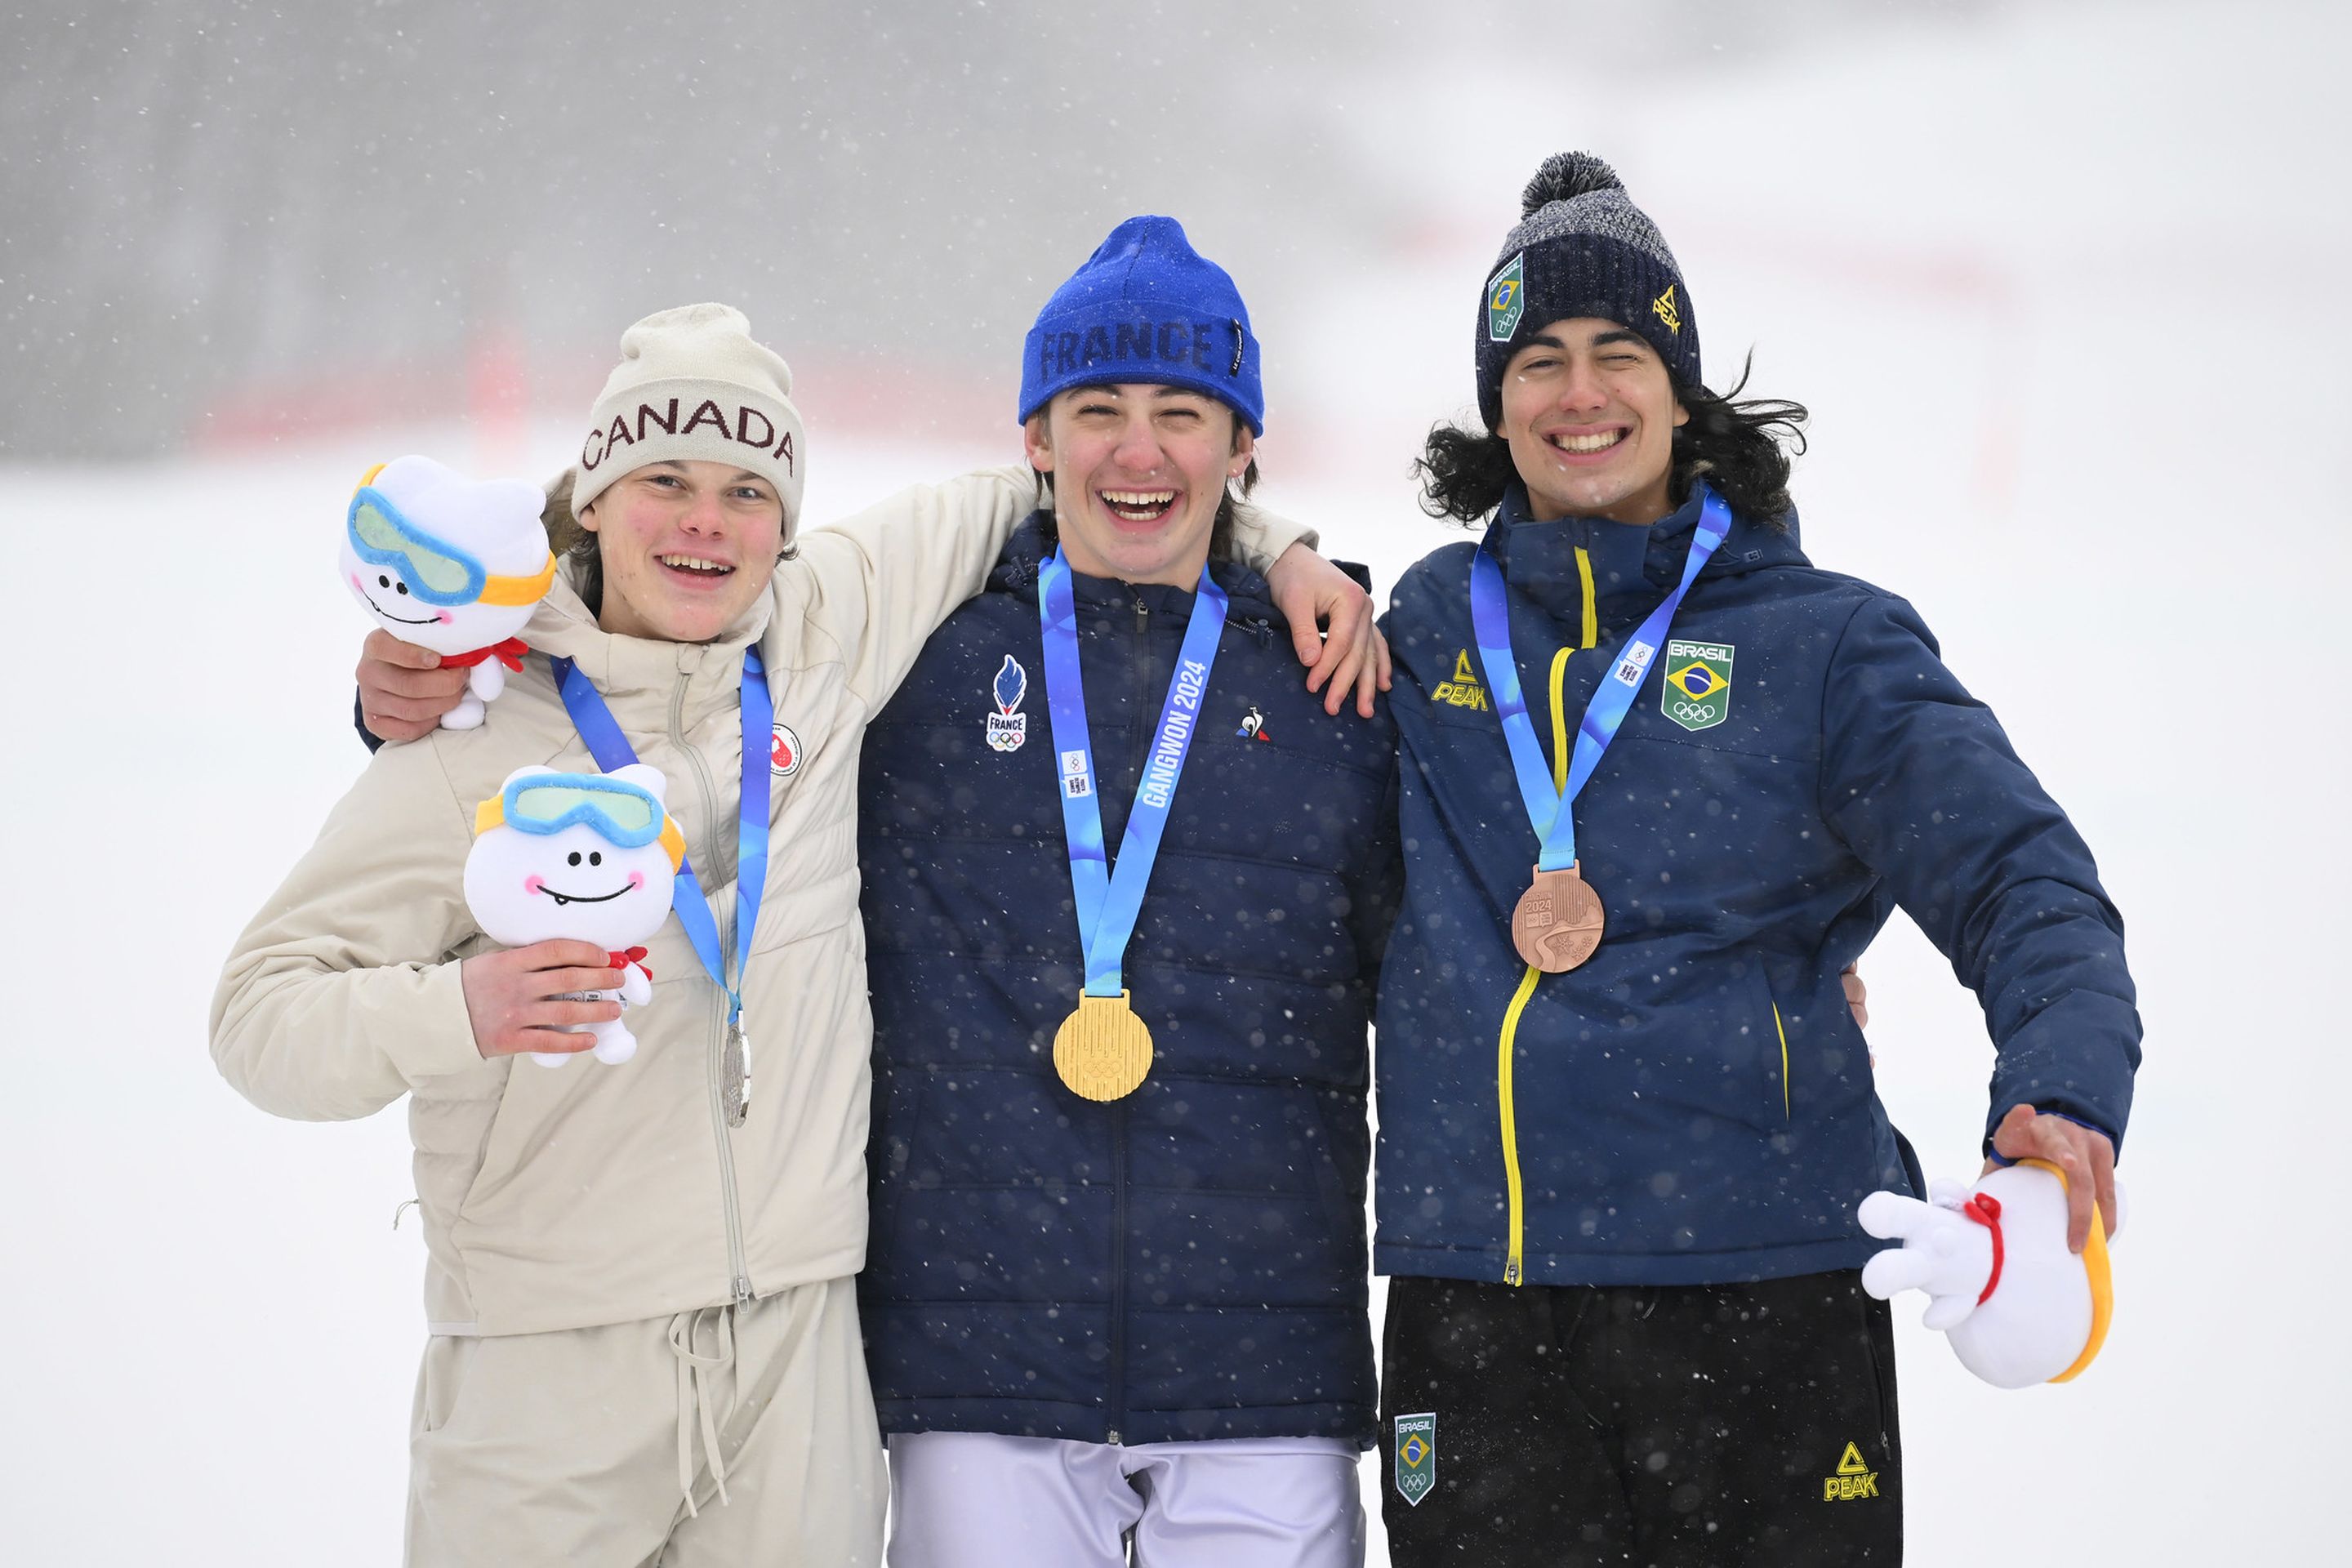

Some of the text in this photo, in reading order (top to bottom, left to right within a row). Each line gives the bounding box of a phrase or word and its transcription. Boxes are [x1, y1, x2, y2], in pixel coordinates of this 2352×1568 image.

[1652, 297, 1681, 336] PEAK
[1040, 323, 1213, 383] FRANCE
[581, 398, 794, 478] CANADA
[1670, 644, 1731, 662] BRASIL
[1431, 681, 1488, 711] PEAK
[990, 717, 1023, 731] FRANCE
[1143, 659, 1206, 808] GANGWON 2024
[1526, 901, 1552, 913] 2024
[1399, 1421, 1432, 1433] BRASIL
[1824, 1472, 1879, 1501] PEAK
